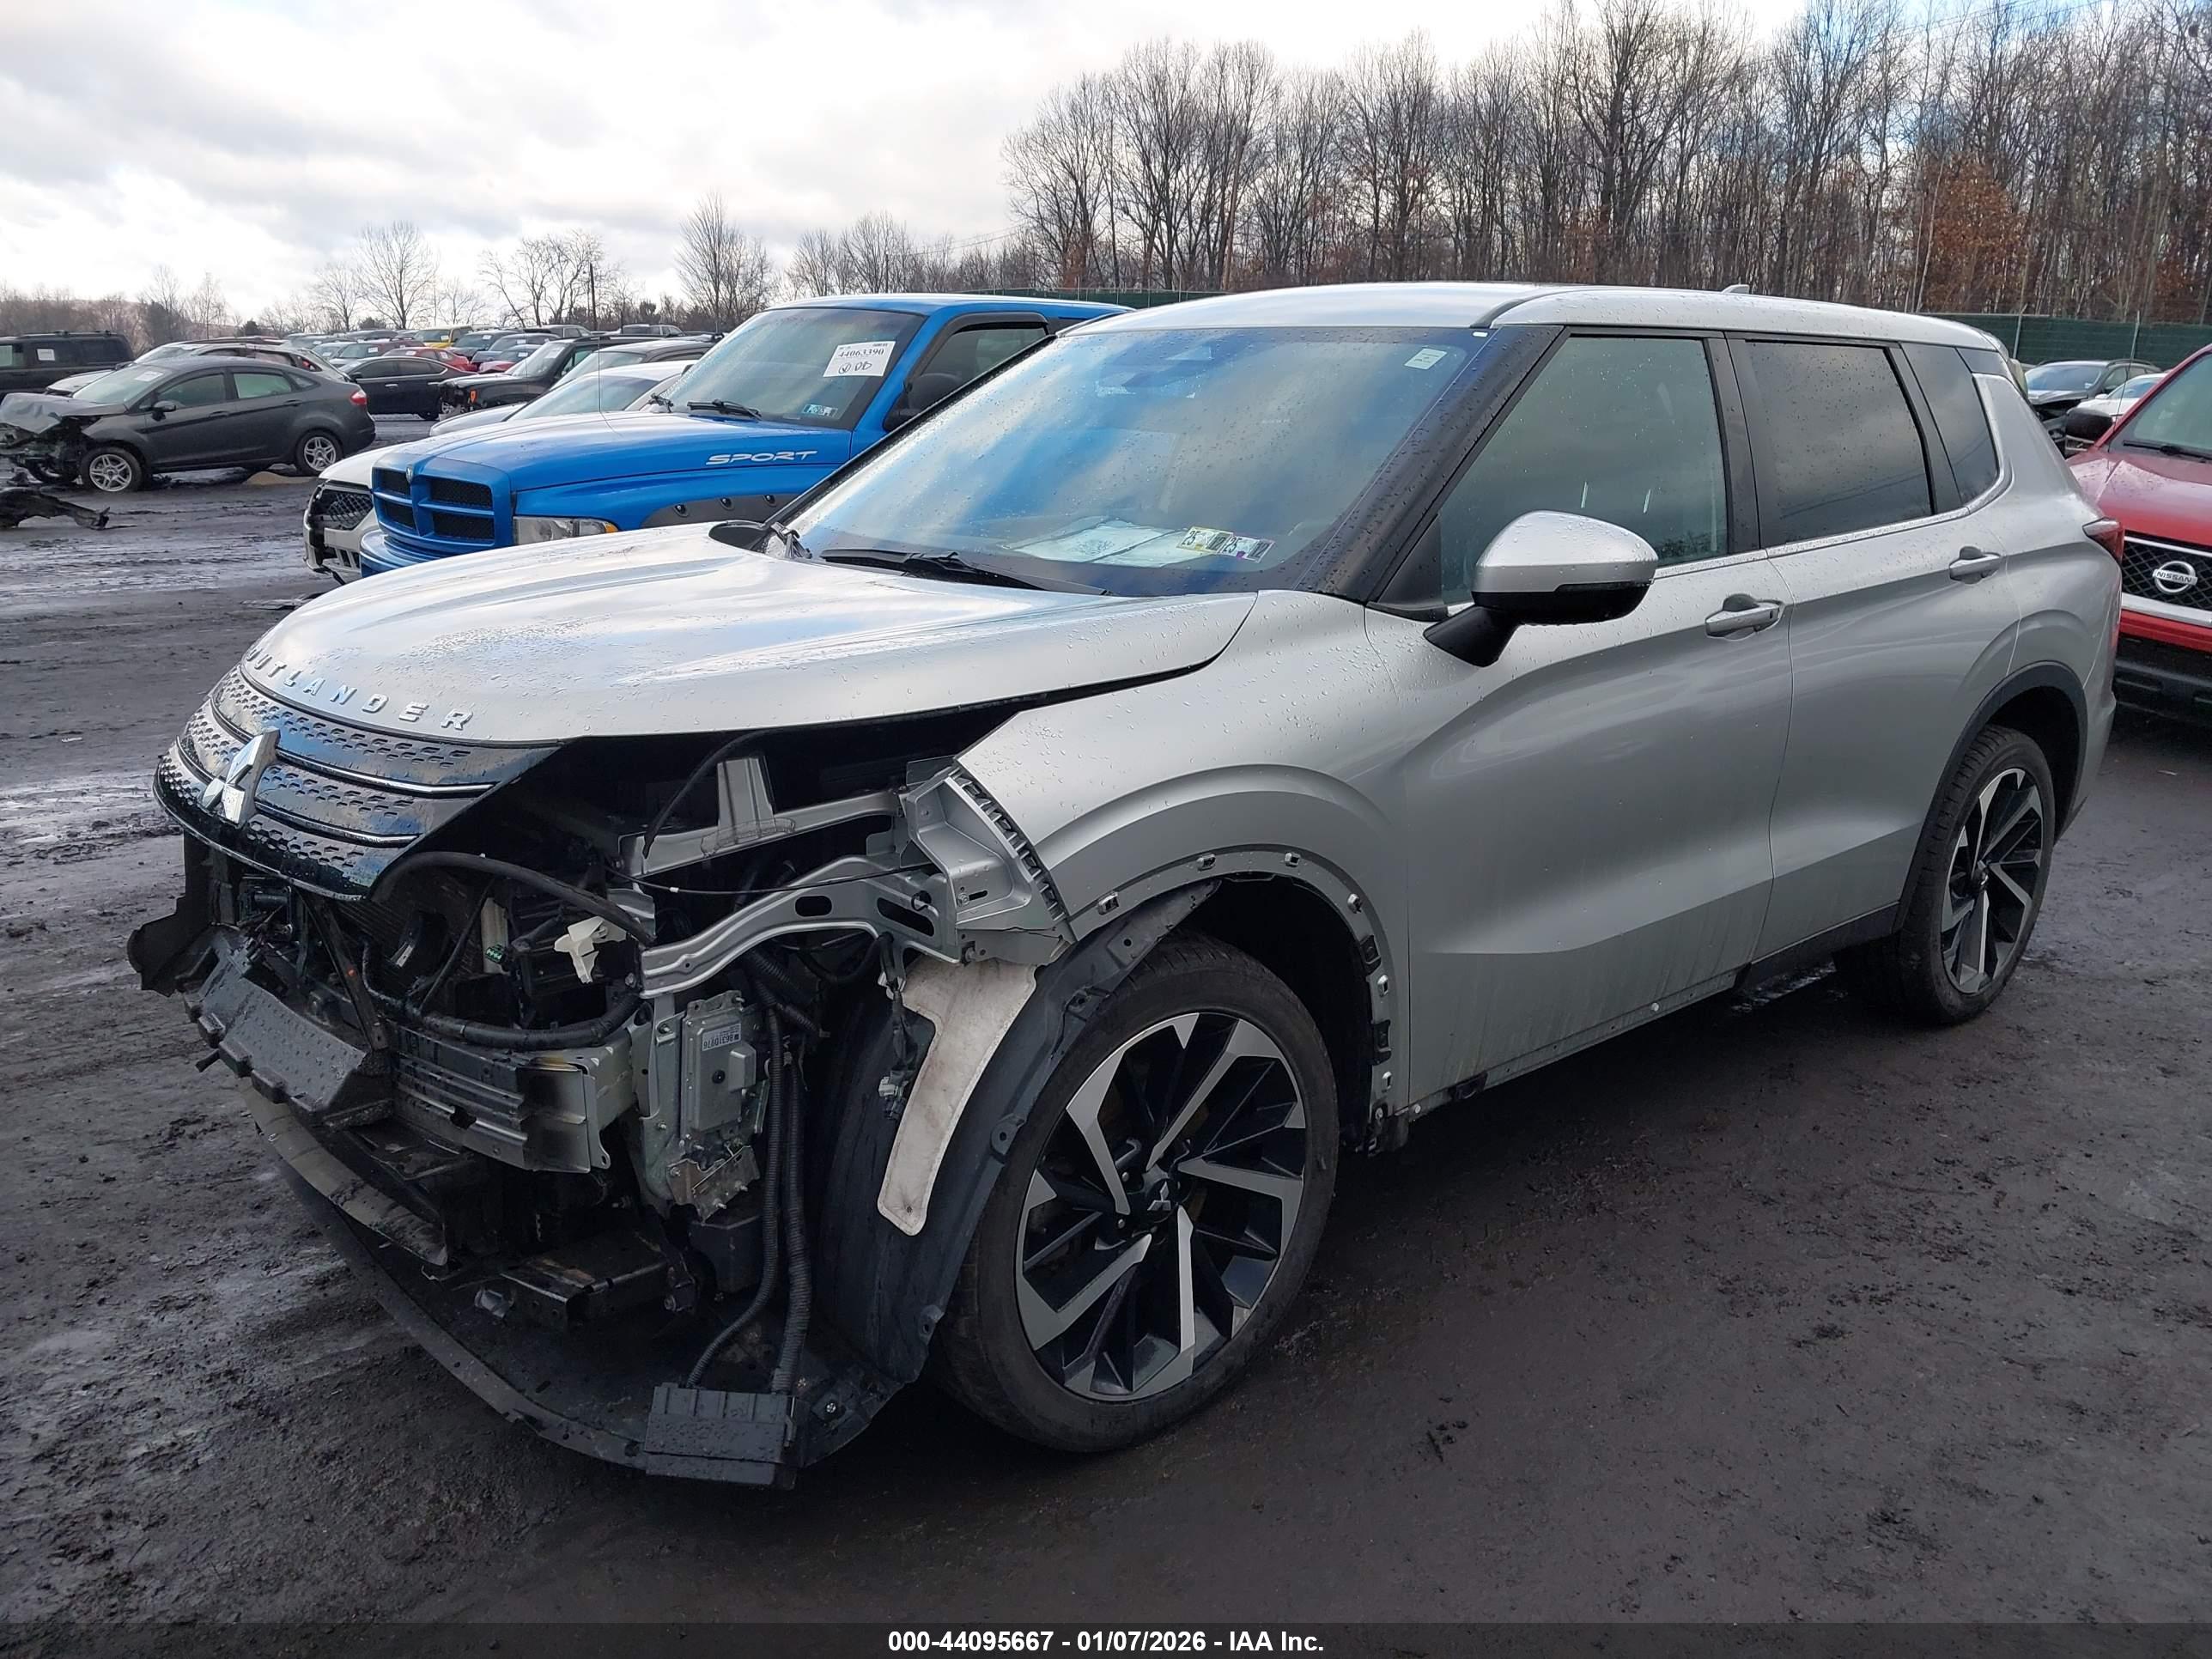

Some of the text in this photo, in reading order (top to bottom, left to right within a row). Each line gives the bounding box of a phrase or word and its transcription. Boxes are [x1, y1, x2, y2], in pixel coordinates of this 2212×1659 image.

[706, 451, 817, 465] SPORT
[1182, 530, 1226, 550] 25 12
[1224, 538, 1270, 558] 25 12
[2156, 571, 2191, 582] NISSAN
[246, 647, 473, 731] OUTLANDER
